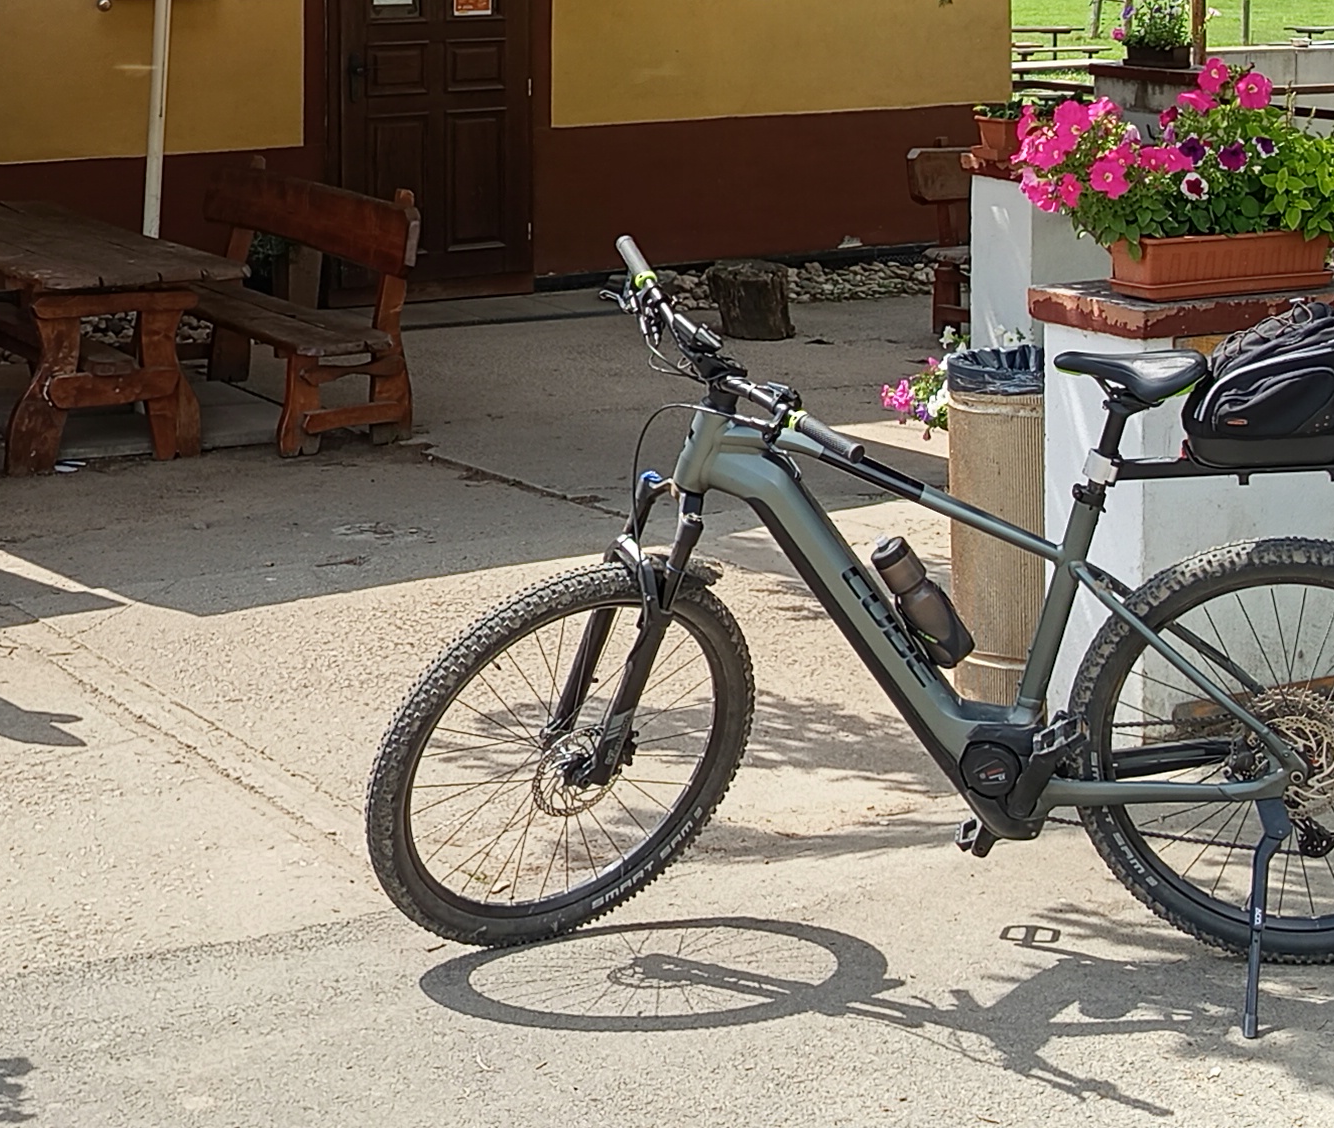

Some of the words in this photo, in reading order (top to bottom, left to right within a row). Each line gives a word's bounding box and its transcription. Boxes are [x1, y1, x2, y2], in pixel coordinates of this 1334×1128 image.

[841, 565, 939, 689] CUBE
[591, 859, 655, 910] SMART
[659, 820, 694, 860] SAM
[1112, 831, 1146, 875] SAM
